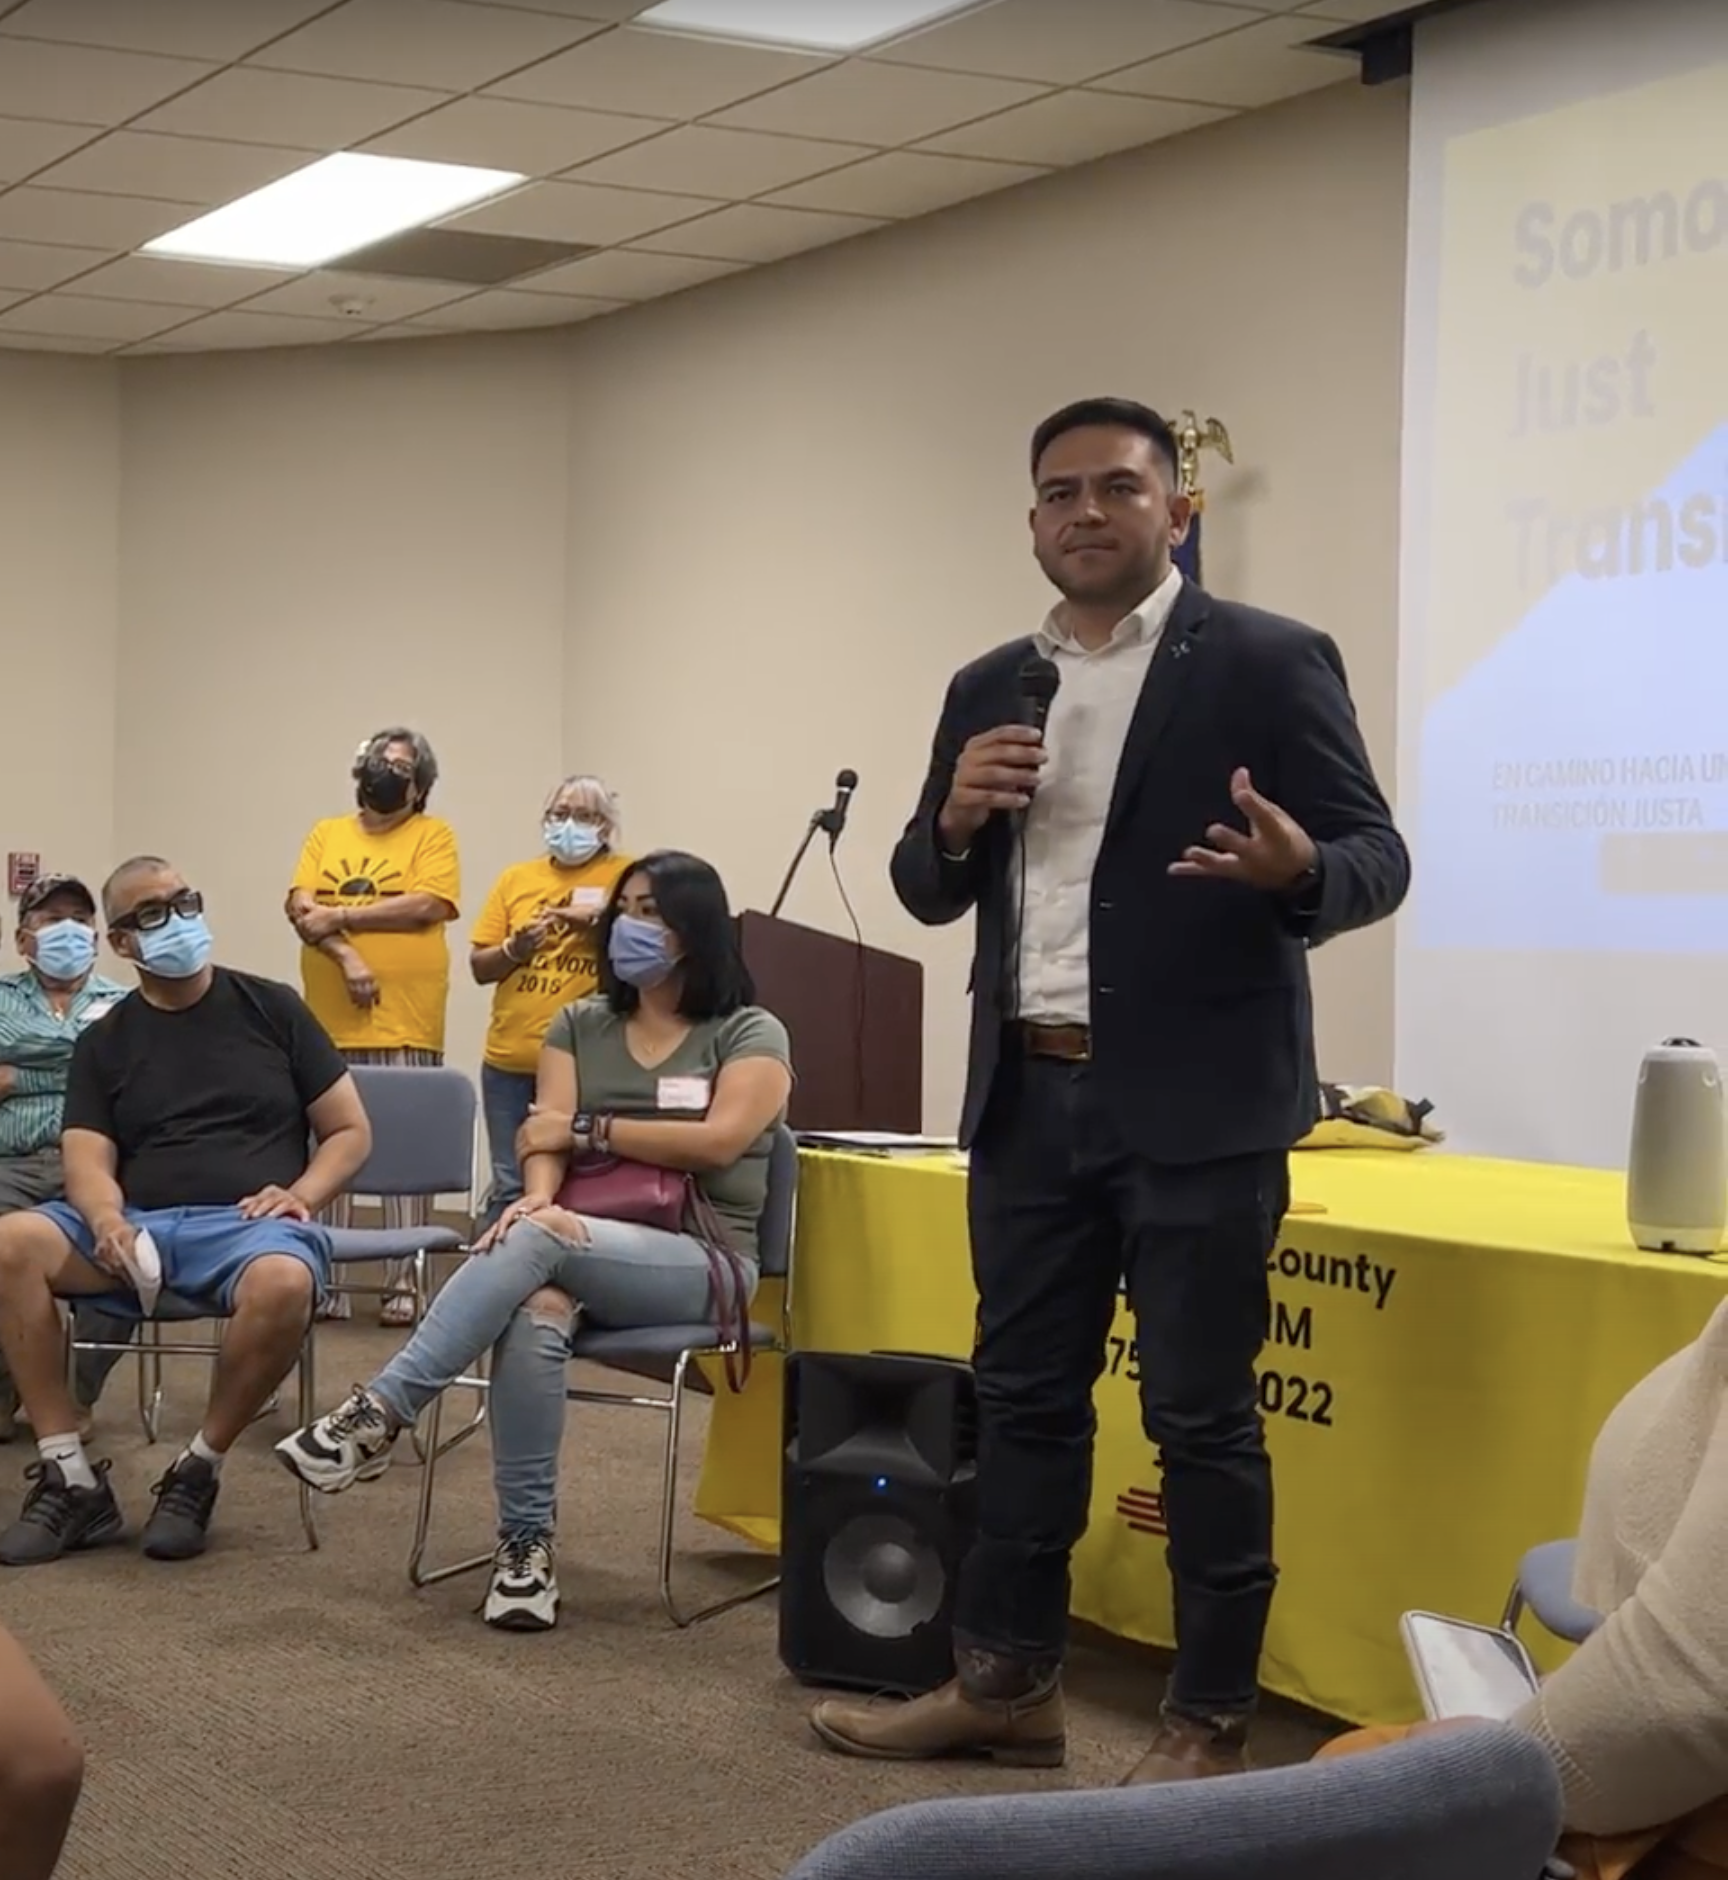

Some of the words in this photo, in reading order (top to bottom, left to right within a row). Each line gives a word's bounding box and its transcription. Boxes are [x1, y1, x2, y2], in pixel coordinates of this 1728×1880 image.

[1508, 328, 1658, 437] Just
[1493, 761, 1521, 789] EN
[1524, 757, 1615, 788] CAMINO
[1622, 754, 1694, 784] HACIA
[1633, 798, 1704, 828] JUSTA
[1267, 1248, 1396, 1310] ounty
[1256, 1370, 1332, 1427] 022
